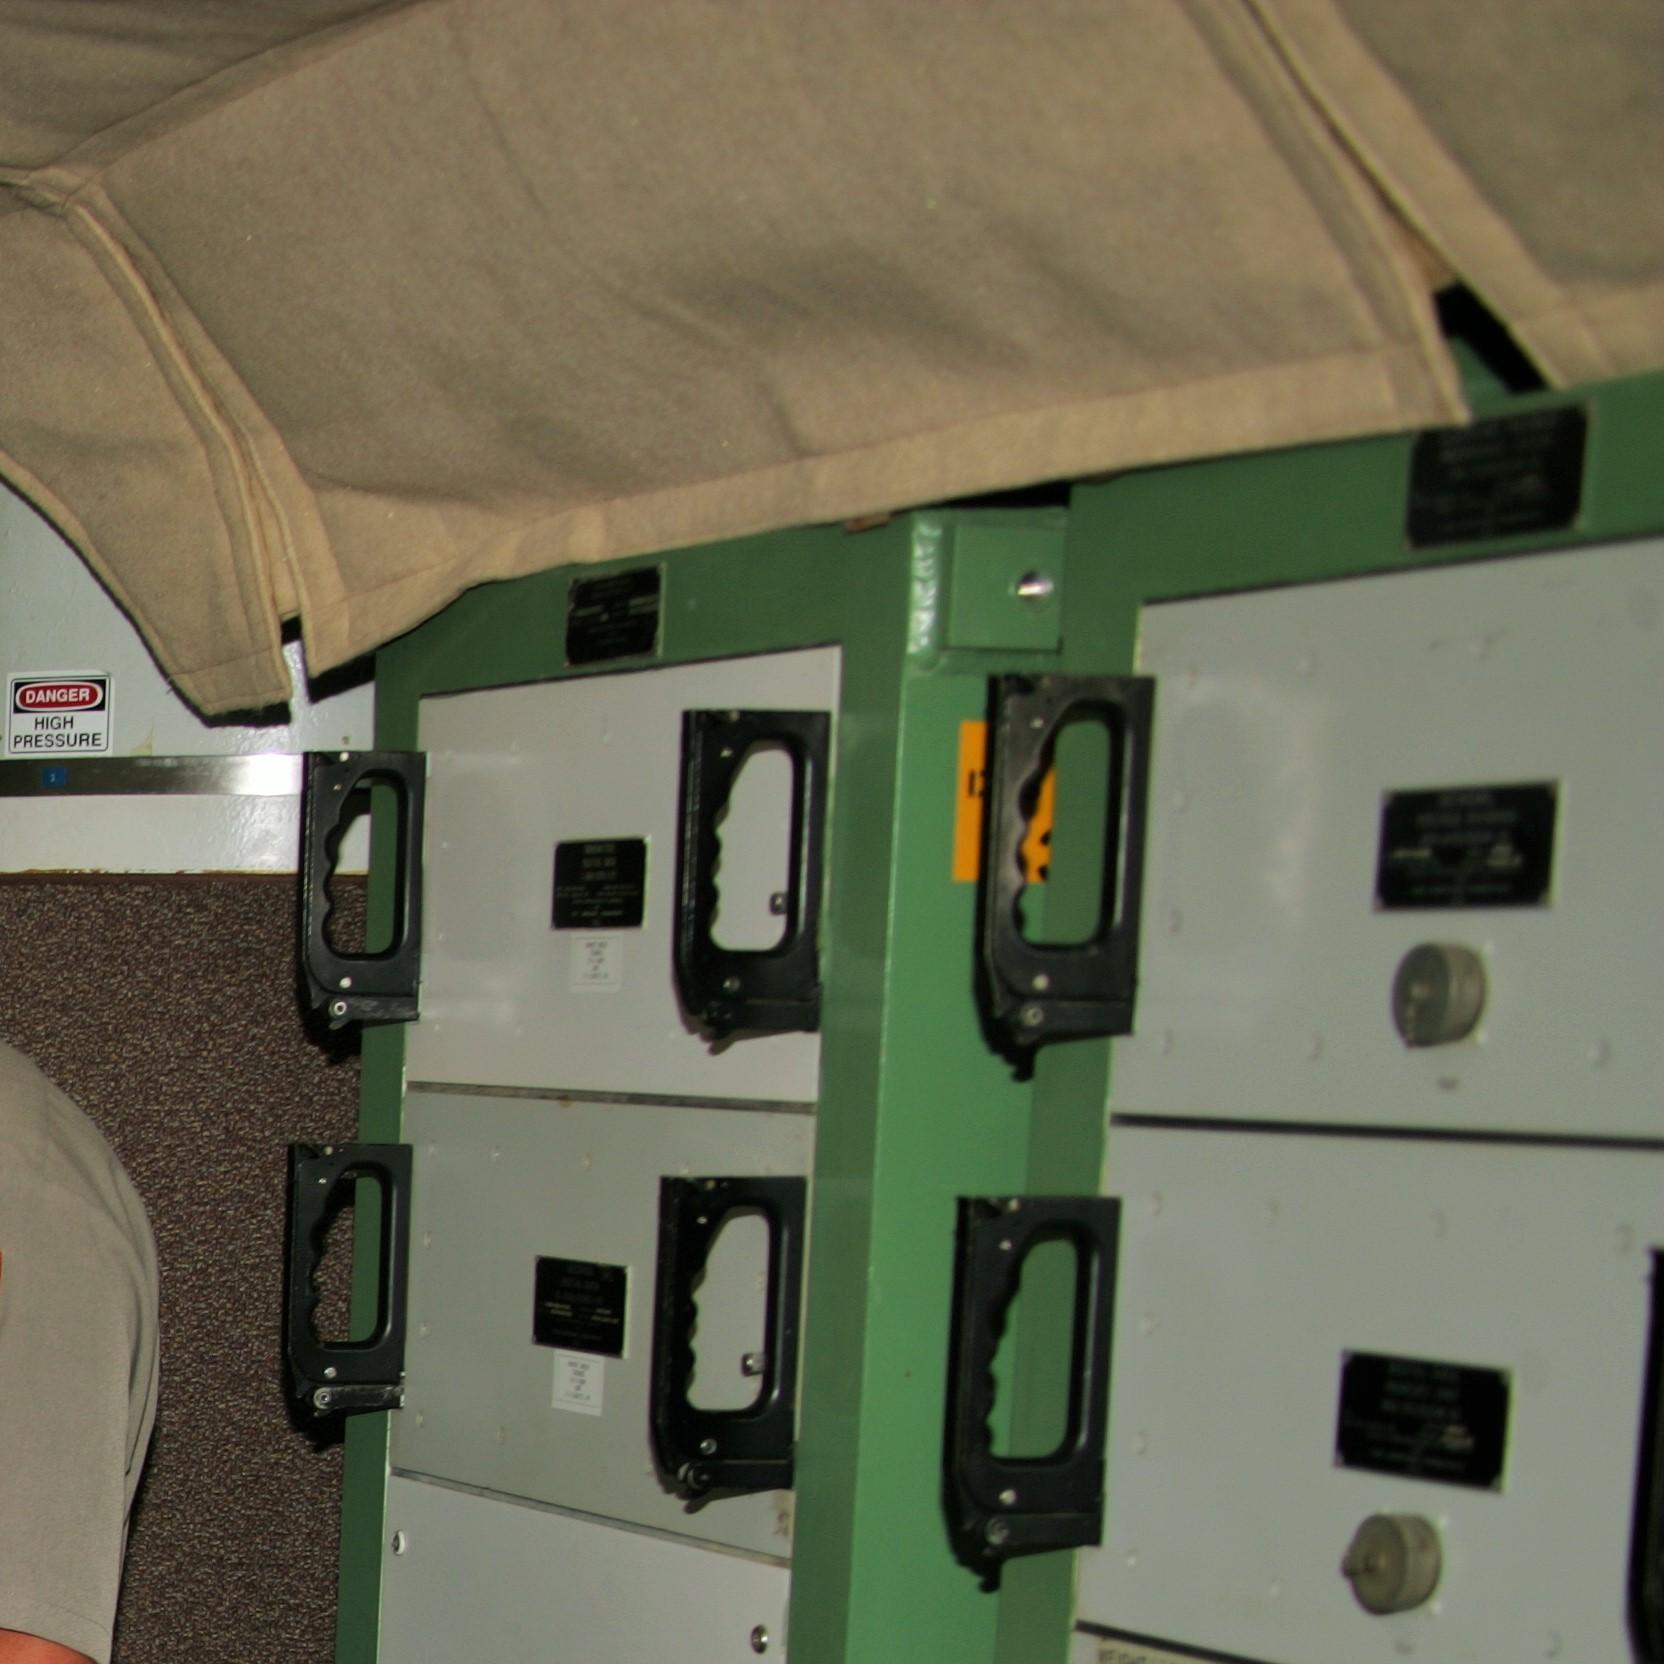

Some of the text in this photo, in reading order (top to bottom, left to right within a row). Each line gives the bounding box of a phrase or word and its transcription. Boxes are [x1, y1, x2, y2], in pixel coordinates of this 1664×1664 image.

[25, 687, 90, 704] DANGER
[34, 716, 75, 731] HIGH
[13, 732, 102, 749] PRESSURE
